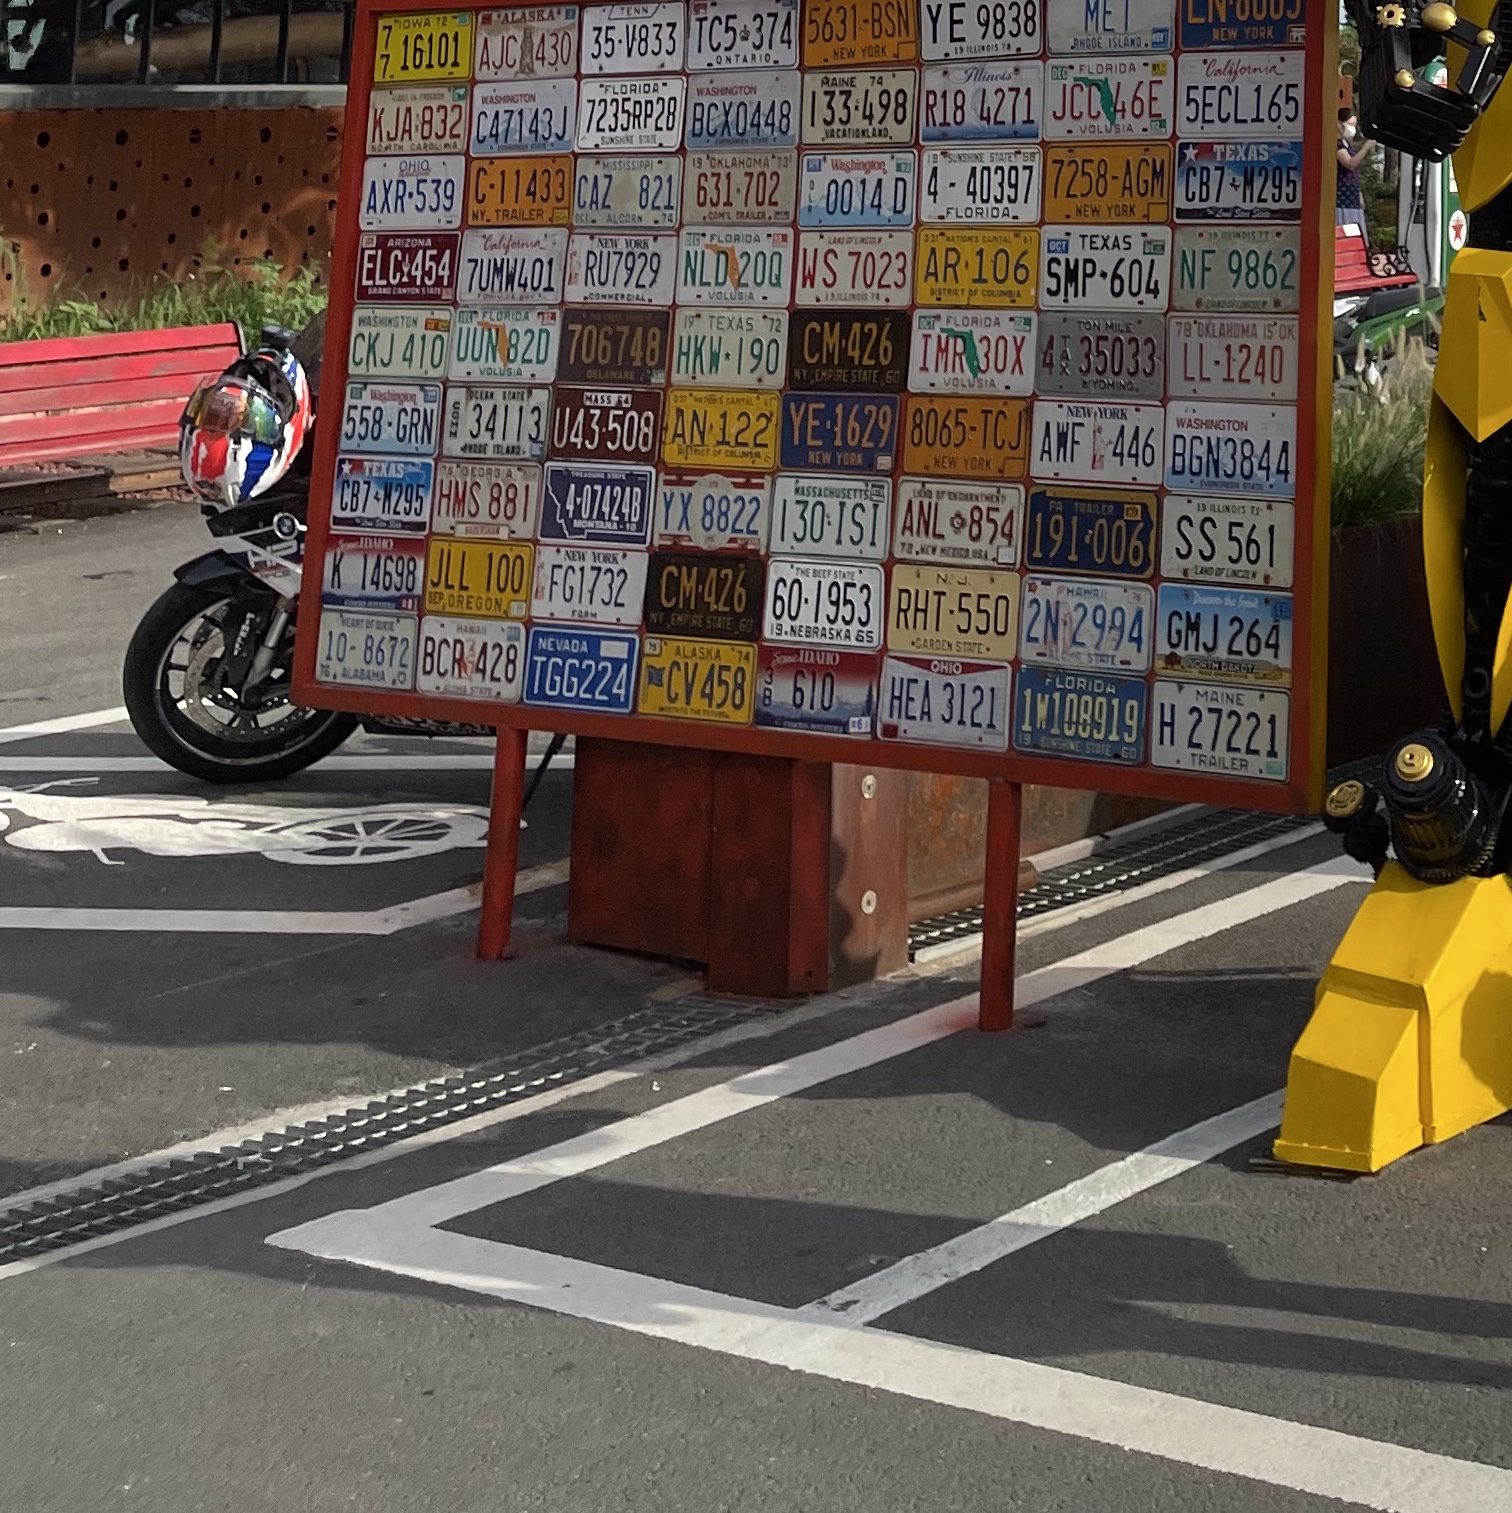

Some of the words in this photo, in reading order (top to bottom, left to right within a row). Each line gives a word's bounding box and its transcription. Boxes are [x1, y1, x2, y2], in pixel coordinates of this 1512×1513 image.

[695, 14, 737, 53] TC5
[752, 12, 792, 50] 374
[808, 0, 910, 44] 5631-BSN
[927, 2, 966, 43] YE
[977, 0, 1037, 40] 9838
[400, 32, 460, 71] 16101
[480, 35, 518, 71] AJC
[535, 32, 571, 67] 430
[716, 53, 771, 65] ONTARIO
[1079, 63, 1136, 74] FLORIDA
[481, 93, 536, 105] WASHINGTON
[604, 83, 660, 95] FLORIDA
[696, 86, 757, 97] WASHINGTON
[821, 76, 857, 88] MAINE
[586, 97, 677, 133] 7235RP28
[925, 89, 966, 127] R18
[980, 87, 1035, 126] 4271
[1186, 84, 1299, 123] 5ECL165
[477, 106, 568, 144] C47143J
[400, 160, 429, 171] OHIO
[1213, 144, 1269, 162] TEXAS
[577, 175, 613, 210] CAZ
[639, 175, 674, 210] 821
[893, 177, 907, 214] D
[927, 166, 938, 204] 4
[966, 165, 1034, 204] 40397
[1052, 158, 1165, 199] 7258-AGM
[1185, 166, 1225, 203] CB7
[495, 209, 544, 220] TRAILER
[946, 207, 1011, 218] FLORIDA
[387, 238, 432, 247] ARIZONA
[710, 234, 761, 243] FLORIDA
[1079, 234, 1132, 251] TEXAS
[361, 250, 402, 286] ELC
[411, 249, 450, 286] 454
[584, 250, 661, 289] RU7929
[802, 248, 838, 289] WS
[848, 251, 907, 289] 7023
[1046, 257, 1097, 298] SMP
[1110, 257, 1159, 299] 604
[1180, 249, 1216, 290] NF
[1228, 249, 1296, 290] 9862
[482, 311, 529, 322] FLORIDA
[709, 315, 753, 331] TEXAS
[946, 317, 1000, 327] FLORIDA
[352, 333, 394, 372] CKJ
[402, 334, 445, 369] 410
[568, 324, 661, 367] 706748
[677, 335, 722, 375] HKW
[737, 337, 780, 375] 190
[1079, 335, 1156, 377] 35033
[585, 394, 612, 405] MASS
[943, 378, 996, 388] VOLUSIA
[469, 403, 542, 442] 34113
[912, 407, 1024, 450] 8065-TCJ
[1067, 406, 1091, 417] NEW
[1098, 407, 1128, 420] YORK
[1176, 418, 1248, 431] WASHINGTON
[1040, 421, 1085, 463] AWF
[1112, 424, 1156, 467] 446
[1172, 434, 1289, 482] BGN3844
[363, 462, 405, 478] TEXAS
[339, 480, 371, 514] CB7
[437, 480, 482, 518] HMS
[489, 482, 530, 522] 881
[663, 492, 693, 531] YX
[702, 494, 761, 535] 8822
[901, 499, 945, 540] ANL
[969, 506, 1015, 546] 854
[564, 551, 589, 562] NEW
[592, 552, 620, 565] YORK
[1175, 515, 1217, 561] SS
[1227, 522, 1275, 568] 561
[331, 552, 345, 589] K
[361, 553, 416, 593] 14698
[430, 549, 469, 592] JLL
[487, 552, 524, 594] 100
[549, 565, 628, 608] FG1732
[448, 595, 501, 612] OREGON
[364, 635, 409, 668] 8672
[538, 638, 588, 653] NEVADA
[790, 625, 851, 642] NEBRASKA
[1167, 610, 1219, 653] GMJ
[1227, 615, 1280, 659] 264
[423, 636, 464, 678] BCR
[475, 641, 518, 683] 428
[931, 661, 962, 674] OHIO
[533, 656, 628, 702] TGG224
[889, 677, 932, 722] HEA
[941, 682, 996, 729] 3121
[1195, 690, 1245, 706] MAINE
[1160, 703, 1175, 747] H
[1187, 706, 1278, 758] 27221
[1190, 753, 1249, 771] TRAILER
